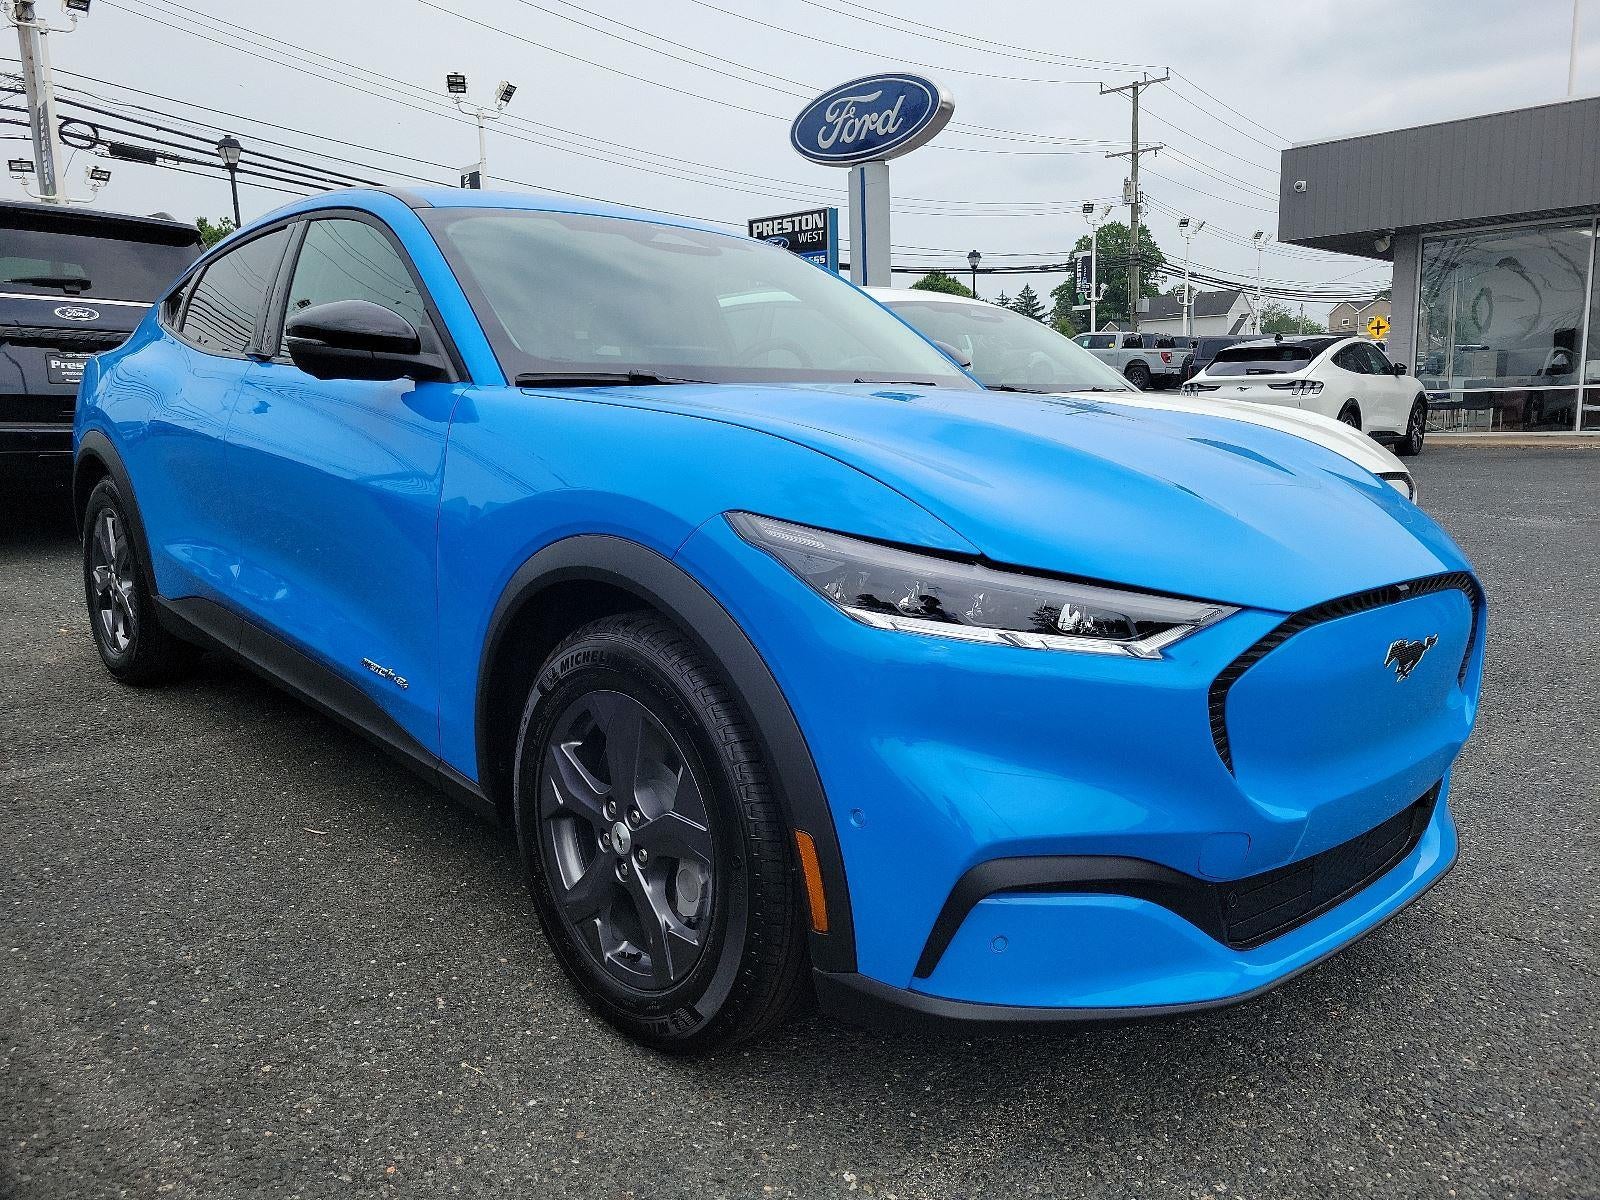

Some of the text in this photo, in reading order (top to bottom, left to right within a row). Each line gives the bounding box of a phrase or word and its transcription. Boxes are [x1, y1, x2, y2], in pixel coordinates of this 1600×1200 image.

[817, 90, 905, 150] Ford
[752, 212, 824, 238] PRESTON
[797, 229, 824, 244] WEST
[560, 649, 620, 674] MICHEL
